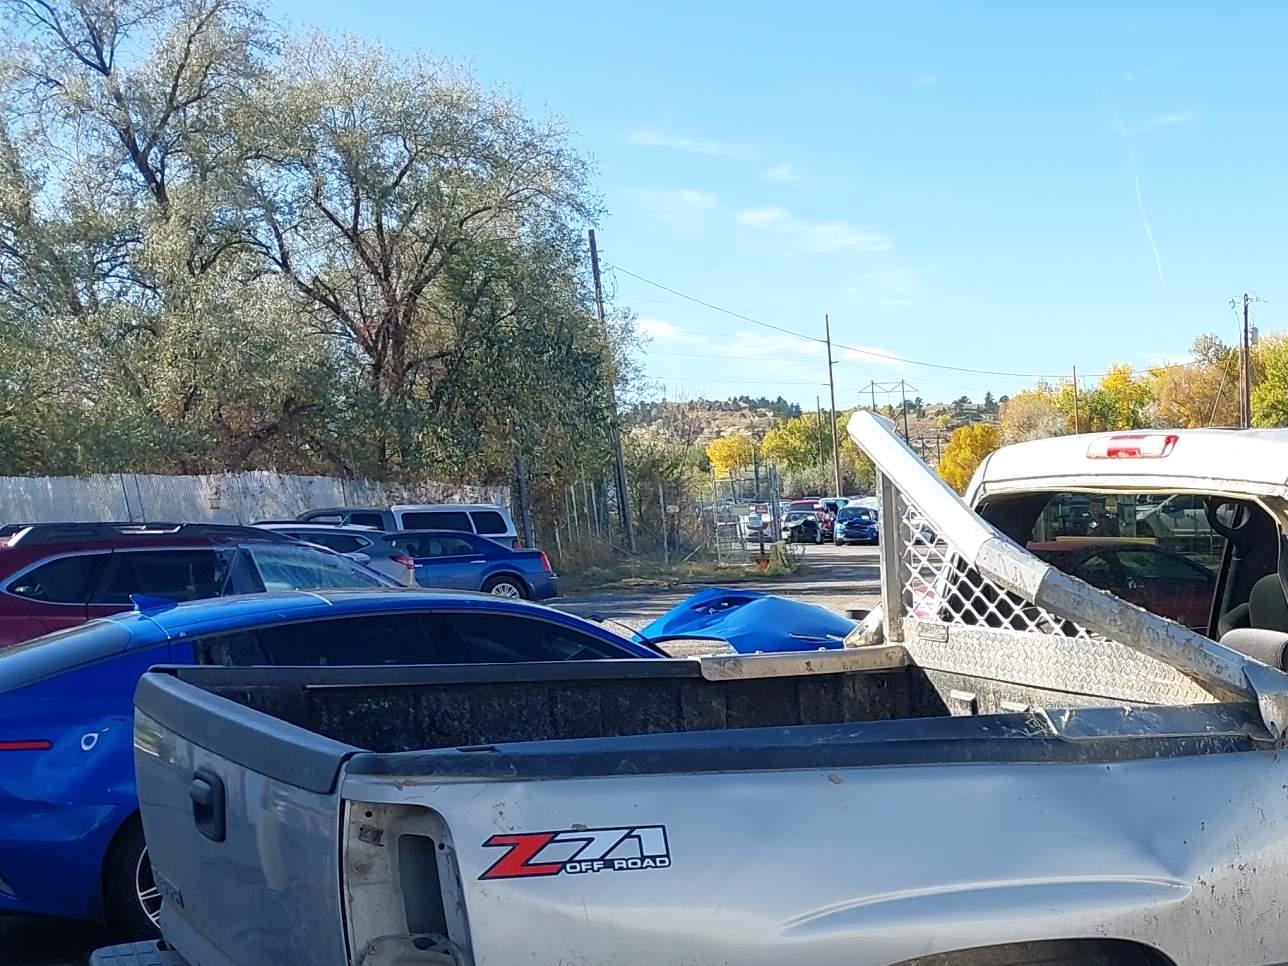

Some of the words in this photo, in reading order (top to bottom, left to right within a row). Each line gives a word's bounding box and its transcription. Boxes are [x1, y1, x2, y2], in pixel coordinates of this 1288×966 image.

[477, 825, 671, 880] Z71
[565, 860, 605, 874] OFF
[613, 856, 671, 871] ROAD
